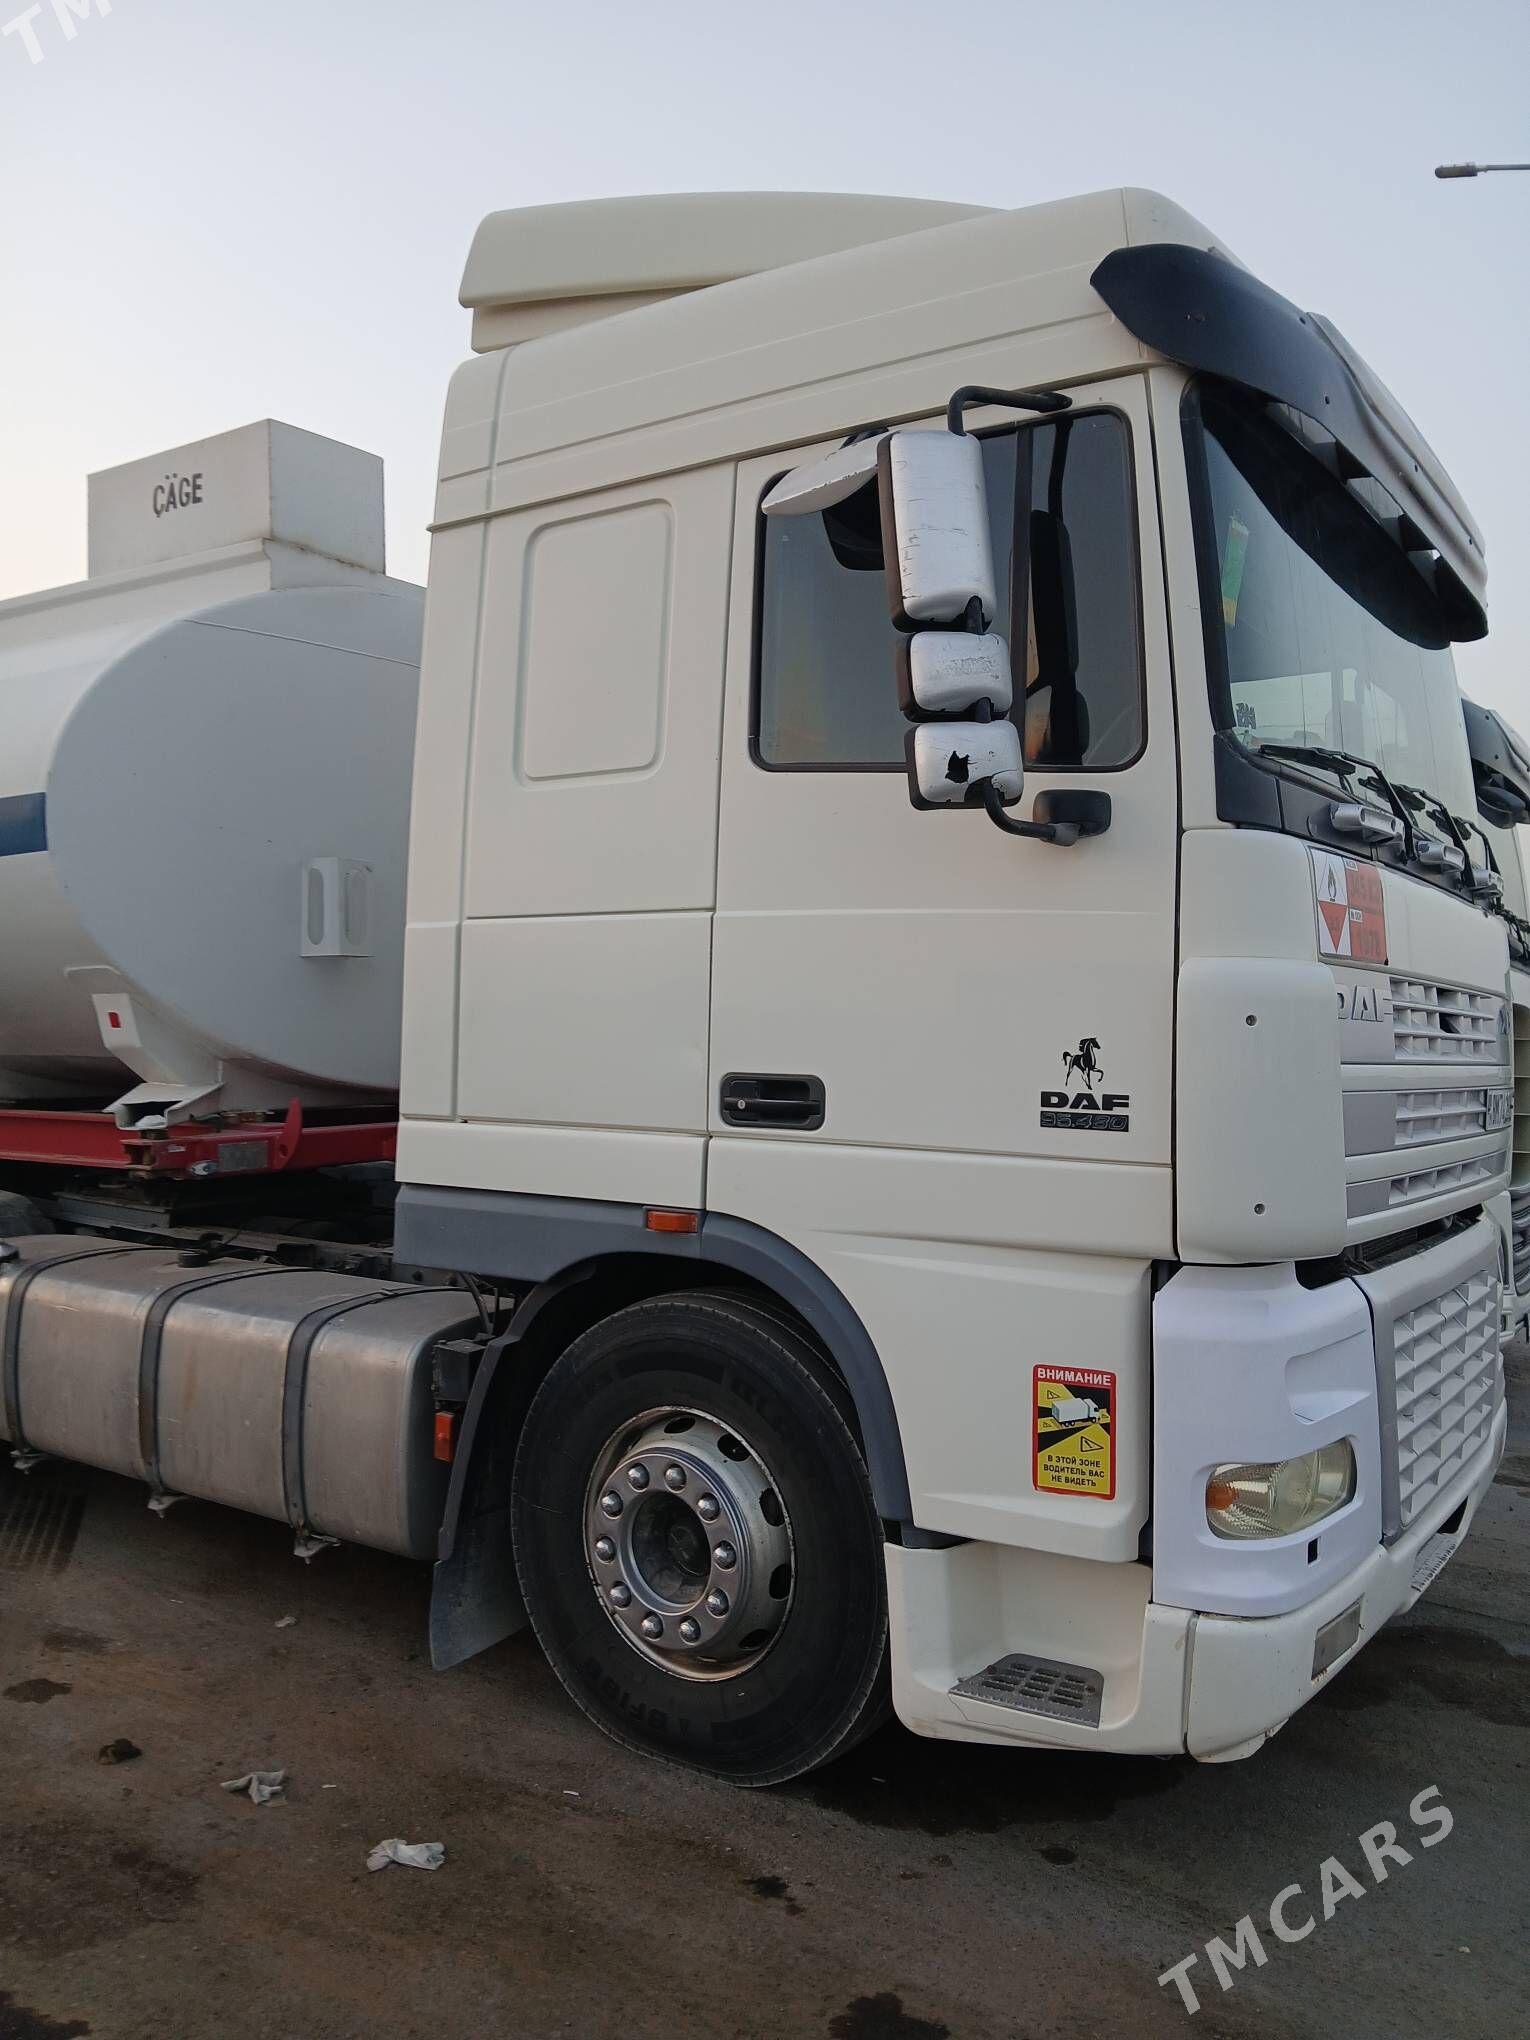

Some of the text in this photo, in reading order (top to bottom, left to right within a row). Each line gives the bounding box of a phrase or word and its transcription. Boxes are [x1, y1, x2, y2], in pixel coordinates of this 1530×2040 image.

[153, 473, 203, 518] ÇÄGE
[1040, 1091, 1130, 1111] DAF
[1037, 1367, 1111, 1386] ВНИМАНИЕ
[1055, 1456, 1077, 1465] ЭТОЙ
[1079, 1458, 1101, 1468] ЗОНЕ
[1043, 1464, 1105, 1478] ВОДИТЕЛЬ ВАС
[1051, 1475, 1063, 1483] НЕ
